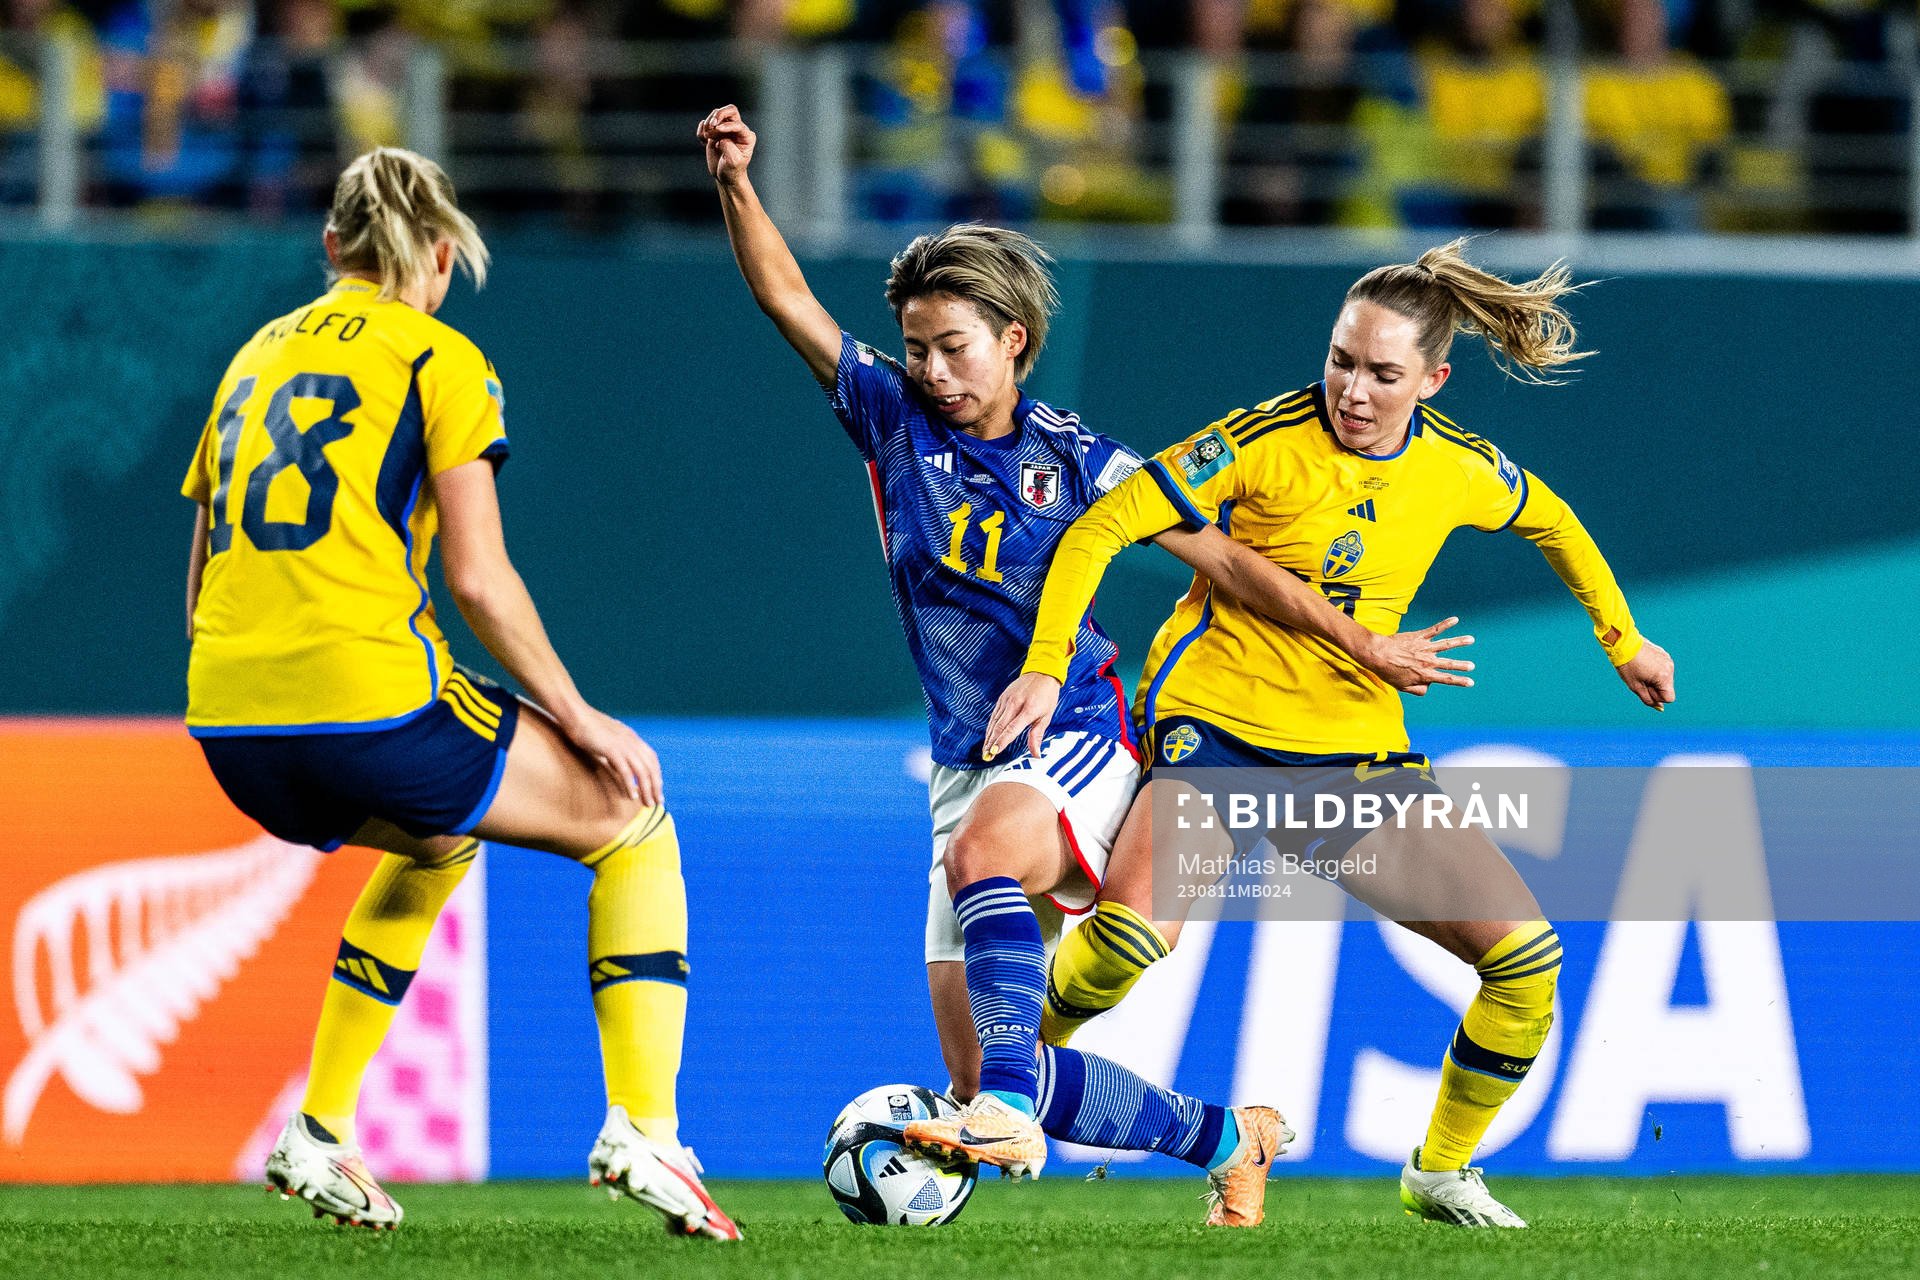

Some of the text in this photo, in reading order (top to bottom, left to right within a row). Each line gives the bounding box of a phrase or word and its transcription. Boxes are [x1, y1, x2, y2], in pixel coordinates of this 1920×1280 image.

[207, 372, 362, 557] 18
[1030, 494, 1048, 503] JFA
[940, 501, 1005, 584] 11
